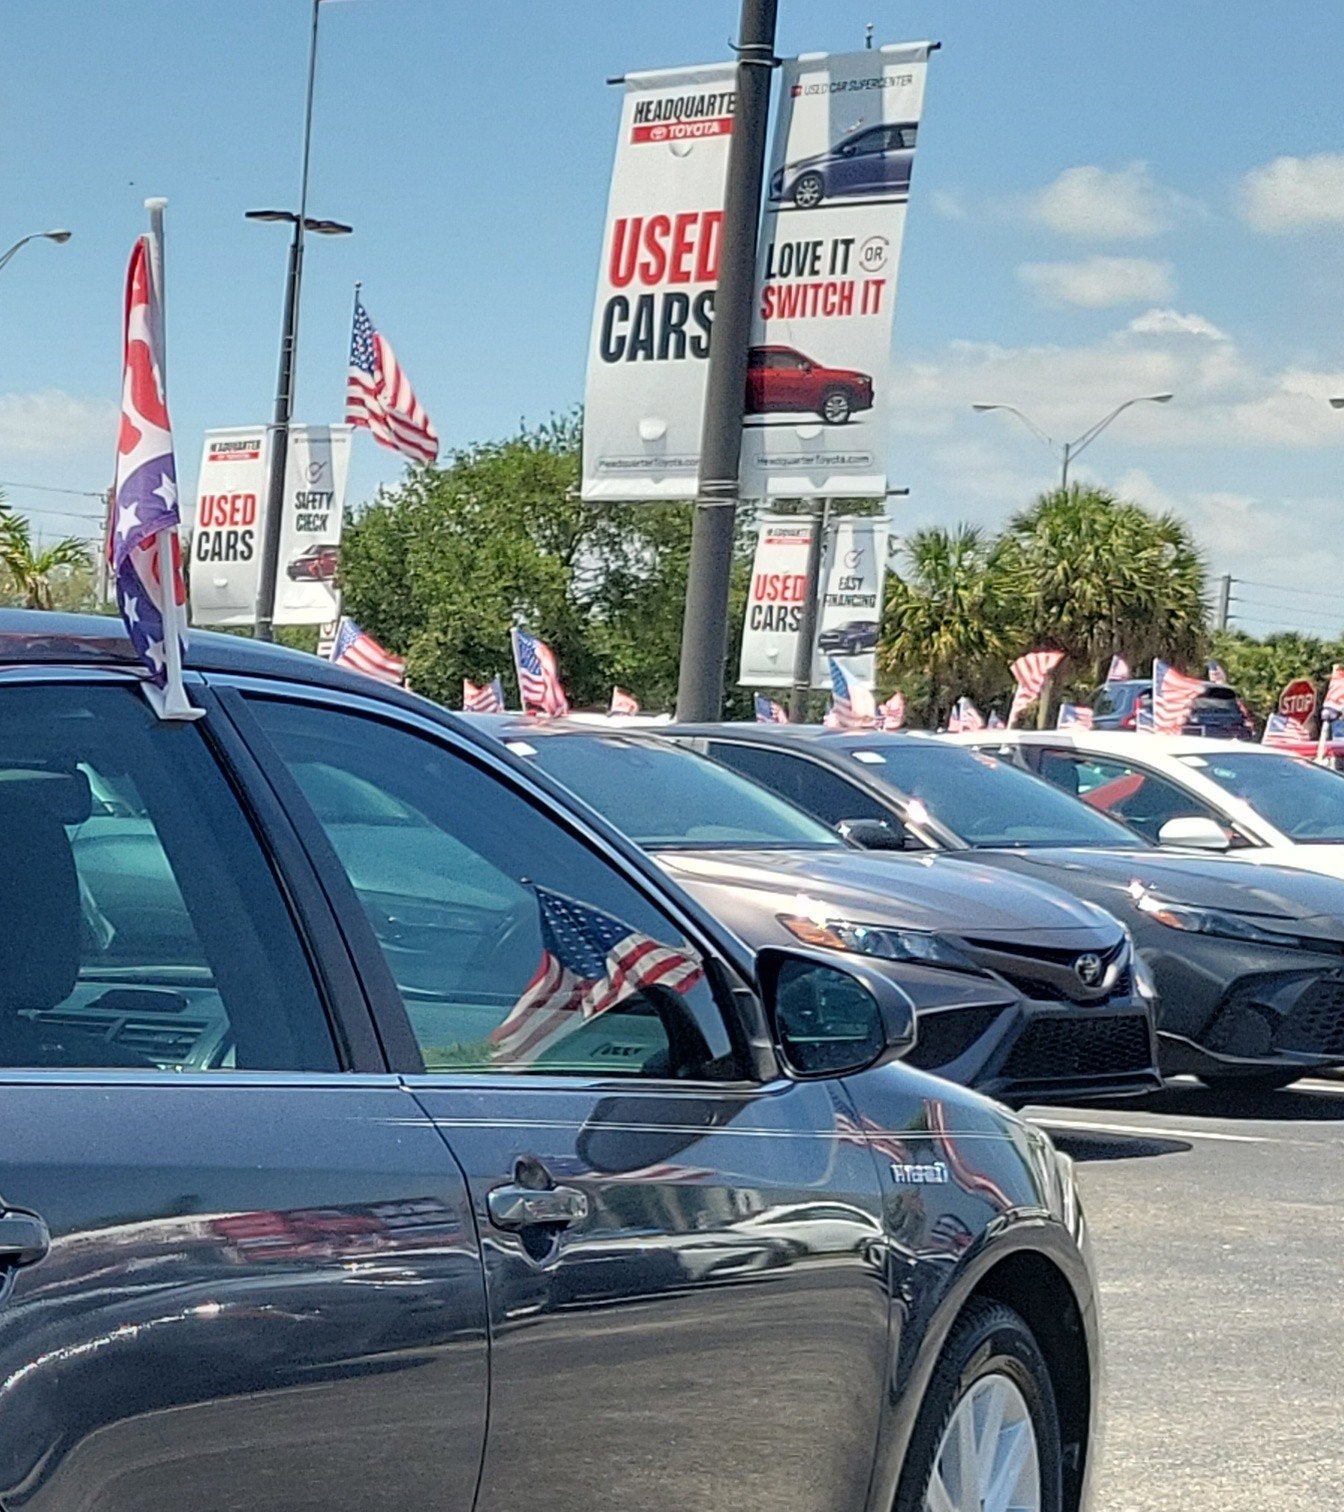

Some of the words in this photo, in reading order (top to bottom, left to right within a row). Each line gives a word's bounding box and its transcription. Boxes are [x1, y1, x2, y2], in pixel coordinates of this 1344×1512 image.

[805, 84, 829, 95] USED
[830, 81, 847, 93] CAR
[633, 92, 737, 124] HEADQUARTE
[668, 122, 720, 138] TOYOTA
[609, 211, 724, 288] USED
[765, 240, 824, 279] LOVE
[829, 238, 855, 275] IT
[864, 246, 883, 261] OR
[760, 281, 855, 320] SWITCH
[861, 279, 886, 315] IT
[600, 290, 717, 363] CARS
[199, 494, 256, 527] USED
[295, 491, 334, 510] SAFETY
[296, 513, 329, 532] CHECK
[196, 530, 254, 562] CARS
[755, 574, 808, 601] USED
[750, 604, 801, 632] CARS
[1281, 693, 1313, 715] STOP
